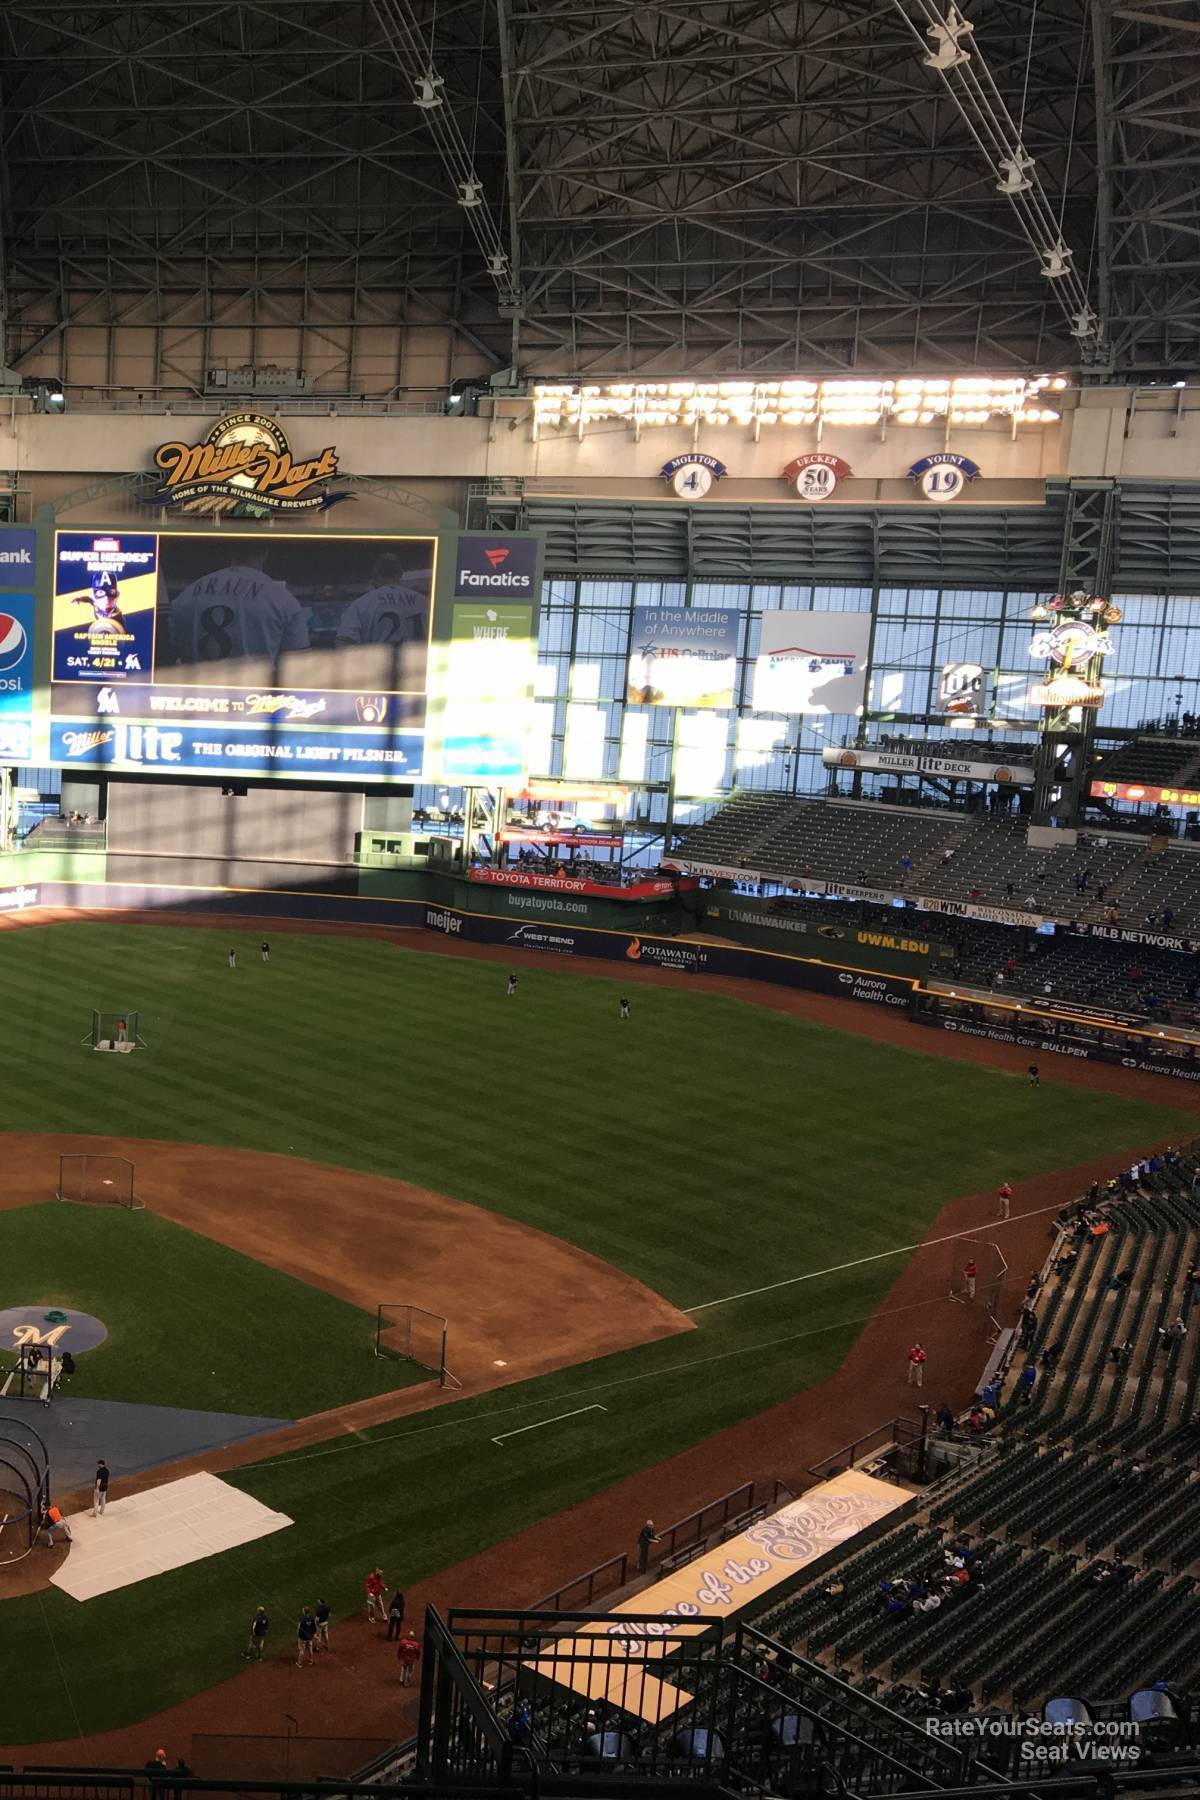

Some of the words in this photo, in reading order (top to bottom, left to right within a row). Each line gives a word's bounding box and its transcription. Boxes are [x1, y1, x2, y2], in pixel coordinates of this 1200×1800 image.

[218, 414, 251, 432] SINCE
[253, 415, 276, 432] 2001
[156, 440, 270, 486] Miller
[246, 446, 339, 494] Park
[671, 455, 717, 468] MOLITOR
[796, 455, 838, 467] UECKER
[926, 456, 965, 466] YOUNT
[683, 470, 699, 491] 4
[803, 468, 828, 486] 50
[927, 471, 959, 493] 19
[172, 488, 196, 501] HOME
[196, 485, 209, 494] OF
[211, 485, 228, 494] THE
[230, 487, 280, 507] MILWAUKEE
[281, 496, 323, 508] BREWERS
[460, 570, 530, 587] Fanatics
[192, 577, 264, 599] BRAUN
[645, 610, 657, 621] In
[660, 610, 681, 622] the
[685, 611, 729, 624] Middle
[200, 604, 235, 658] 8
[473, 627, 510, 640] WHERE
[645, 624, 659, 635] of
[661, 625, 726, 637] Anywhere
[66, 656, 91, 667] SAT,
[92, 657, 116, 668] 4/21
[149, 695, 231, 713] WELCOME
[232, 701, 244, 712] TO
[62, 729, 115, 757] Miller
[111, 724, 182, 766] Lite
[192, 741, 223, 756] THE
[225, 742, 293, 759] ORIGINAL
[296, 745, 341, 761] LIGHT
[342, 747, 407, 764] PILSNER.
[878, 756, 915, 767] MILLER
[916, 756, 943, 771] Lite
[943, 763, 972, 773] DECK
[490, 871, 531, 885] TOYOTA
[532, 876, 587, 891] TERRITORY
[846, 888, 879, 899] BEERPEN
[508, 893, 588, 915] buyatoyota.com
[923, 899, 940, 910] 620
[940, 900, 967, 916] WTMJ
[426, 909, 463, 934] meijer
[523, 932, 550, 942] WEST
[549, 935, 575, 946] BEND
[857, 931, 929, 954] UWM.EDU
[1092, 925, 1120, 939] MLB
[1120, 931, 1183, 950] NETWORK
[855, 976, 887, 991] Aurora
[852, 987, 884, 1002] Health
[885, 993, 907, 1006] Care
[1051, 1003, 1082, 1014] Aurora
[1083, 1007, 1115, 1020] Health
[1116, 1013, 1140, 1024] Care
[958, 1023, 987, 1037] Aurora
[987, 1029, 1015, 1043] Health
[1017, 1035, 1036, 1047] Care
[1041, 1041, 1089, 1058] BULLPEN
[1138, 1061, 1171, 1074] Aurora
[12, 1324, 74, 1349] M
[696, 1571, 732, 1606] of
[724, 1557, 772, 1585] the
